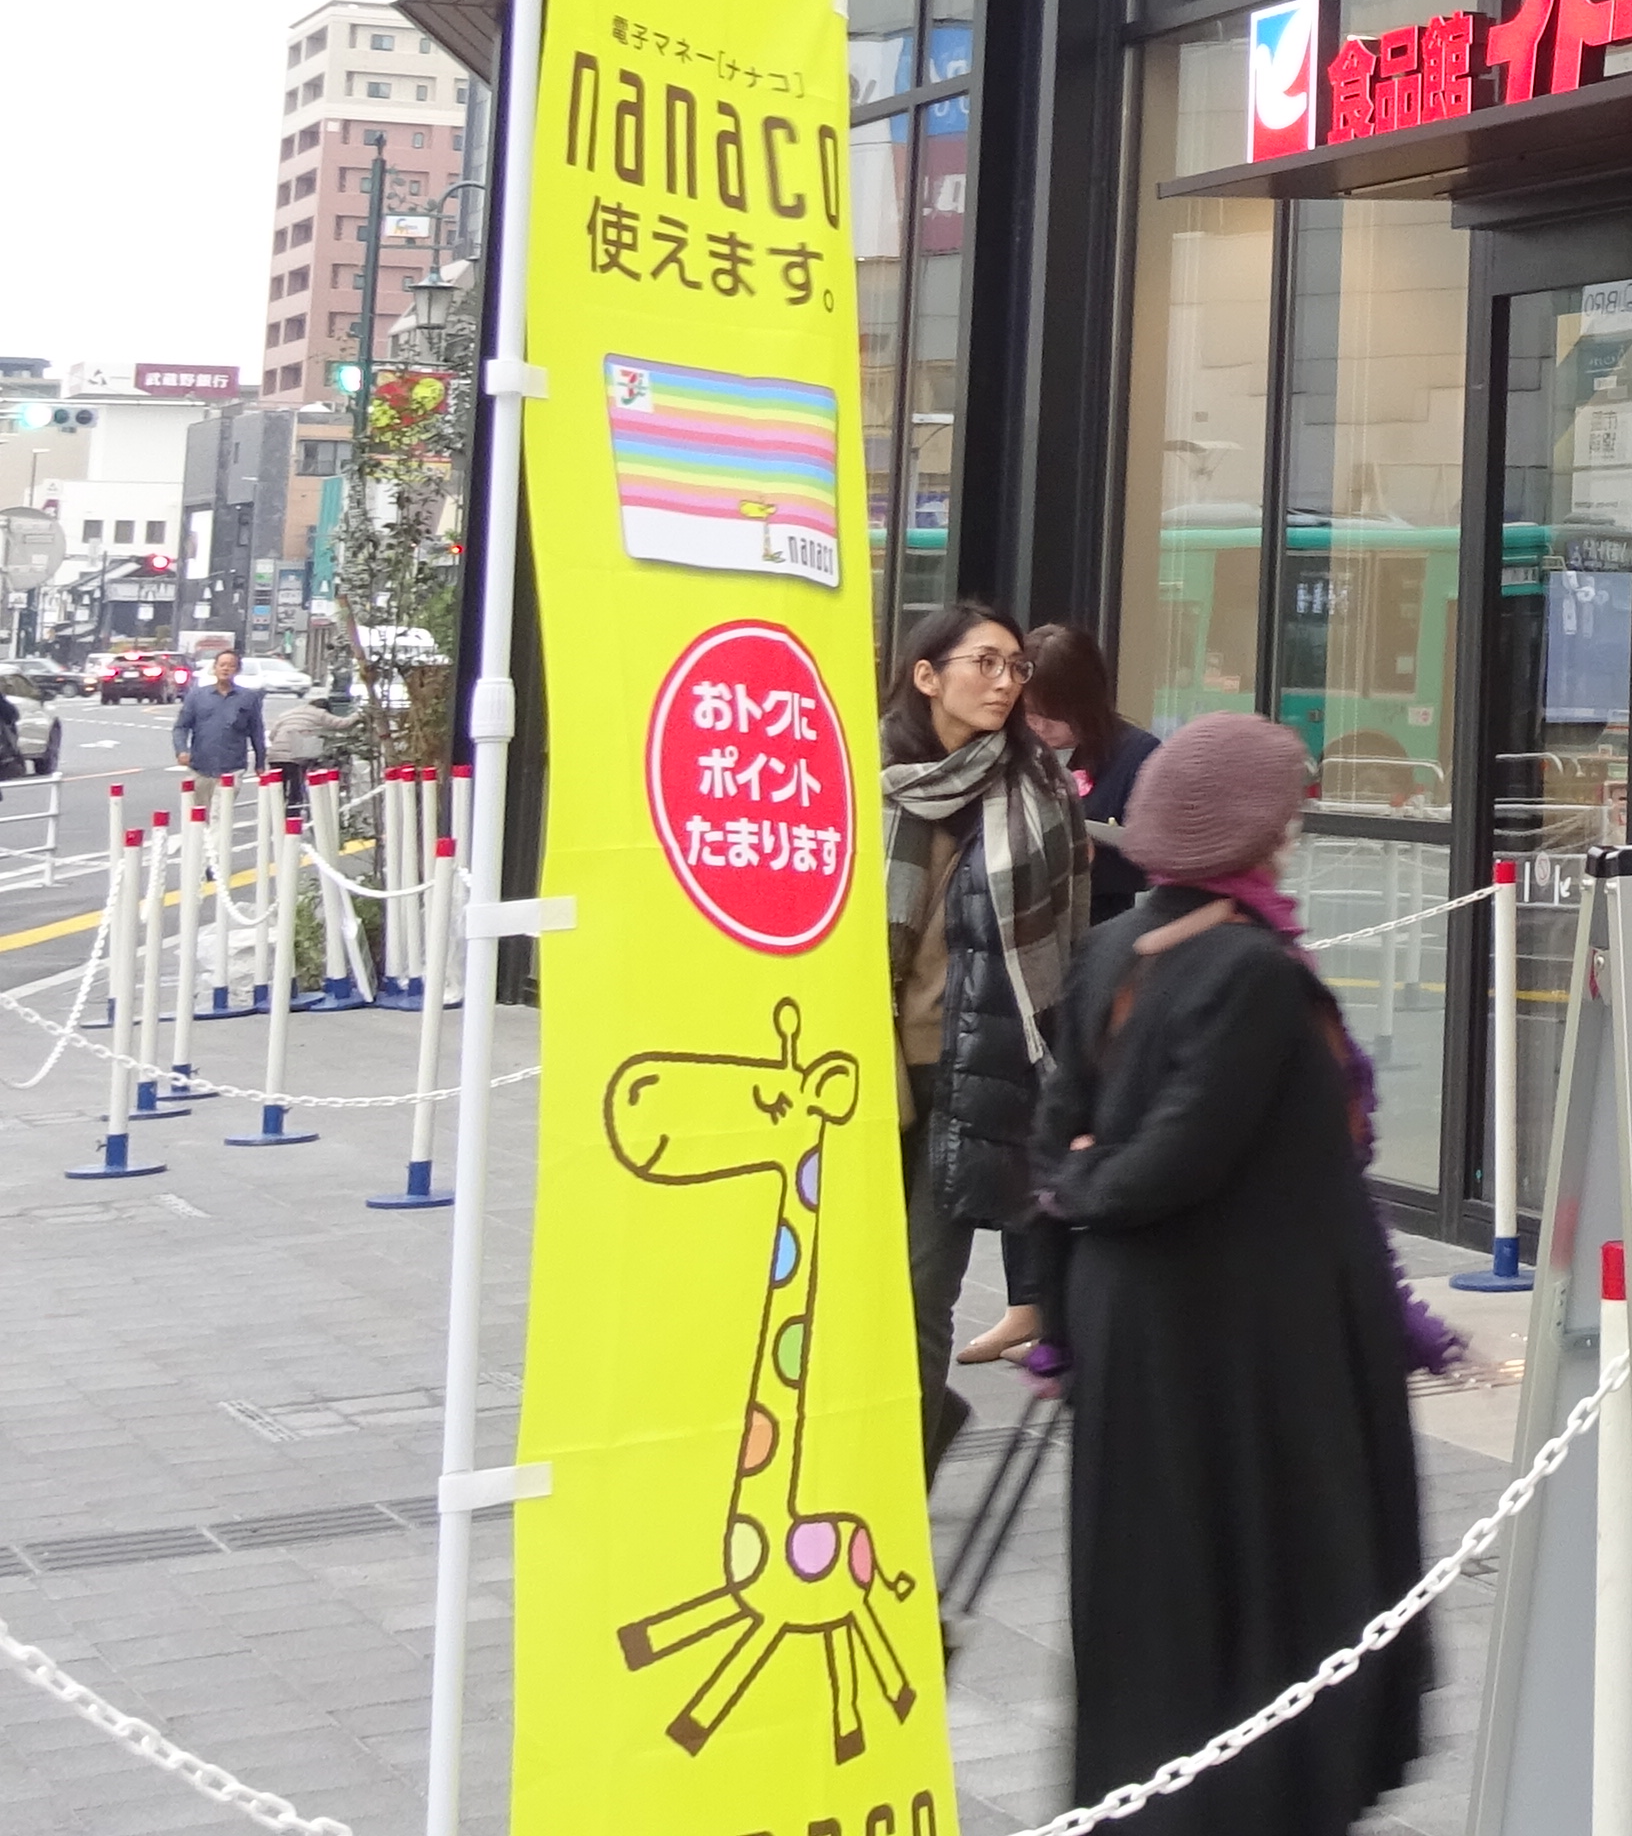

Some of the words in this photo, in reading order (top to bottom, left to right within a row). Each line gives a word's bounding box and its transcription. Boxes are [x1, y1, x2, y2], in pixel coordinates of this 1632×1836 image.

[1327, 10, 1478, 145] 食品館
[566, 49, 840, 231] nanaco
[586, 194, 836, 314] 使えます。
[691, 680, 818, 742] おトクに
[697, 745, 822, 808] ポイント
[685, 814, 842, 876] たまります
